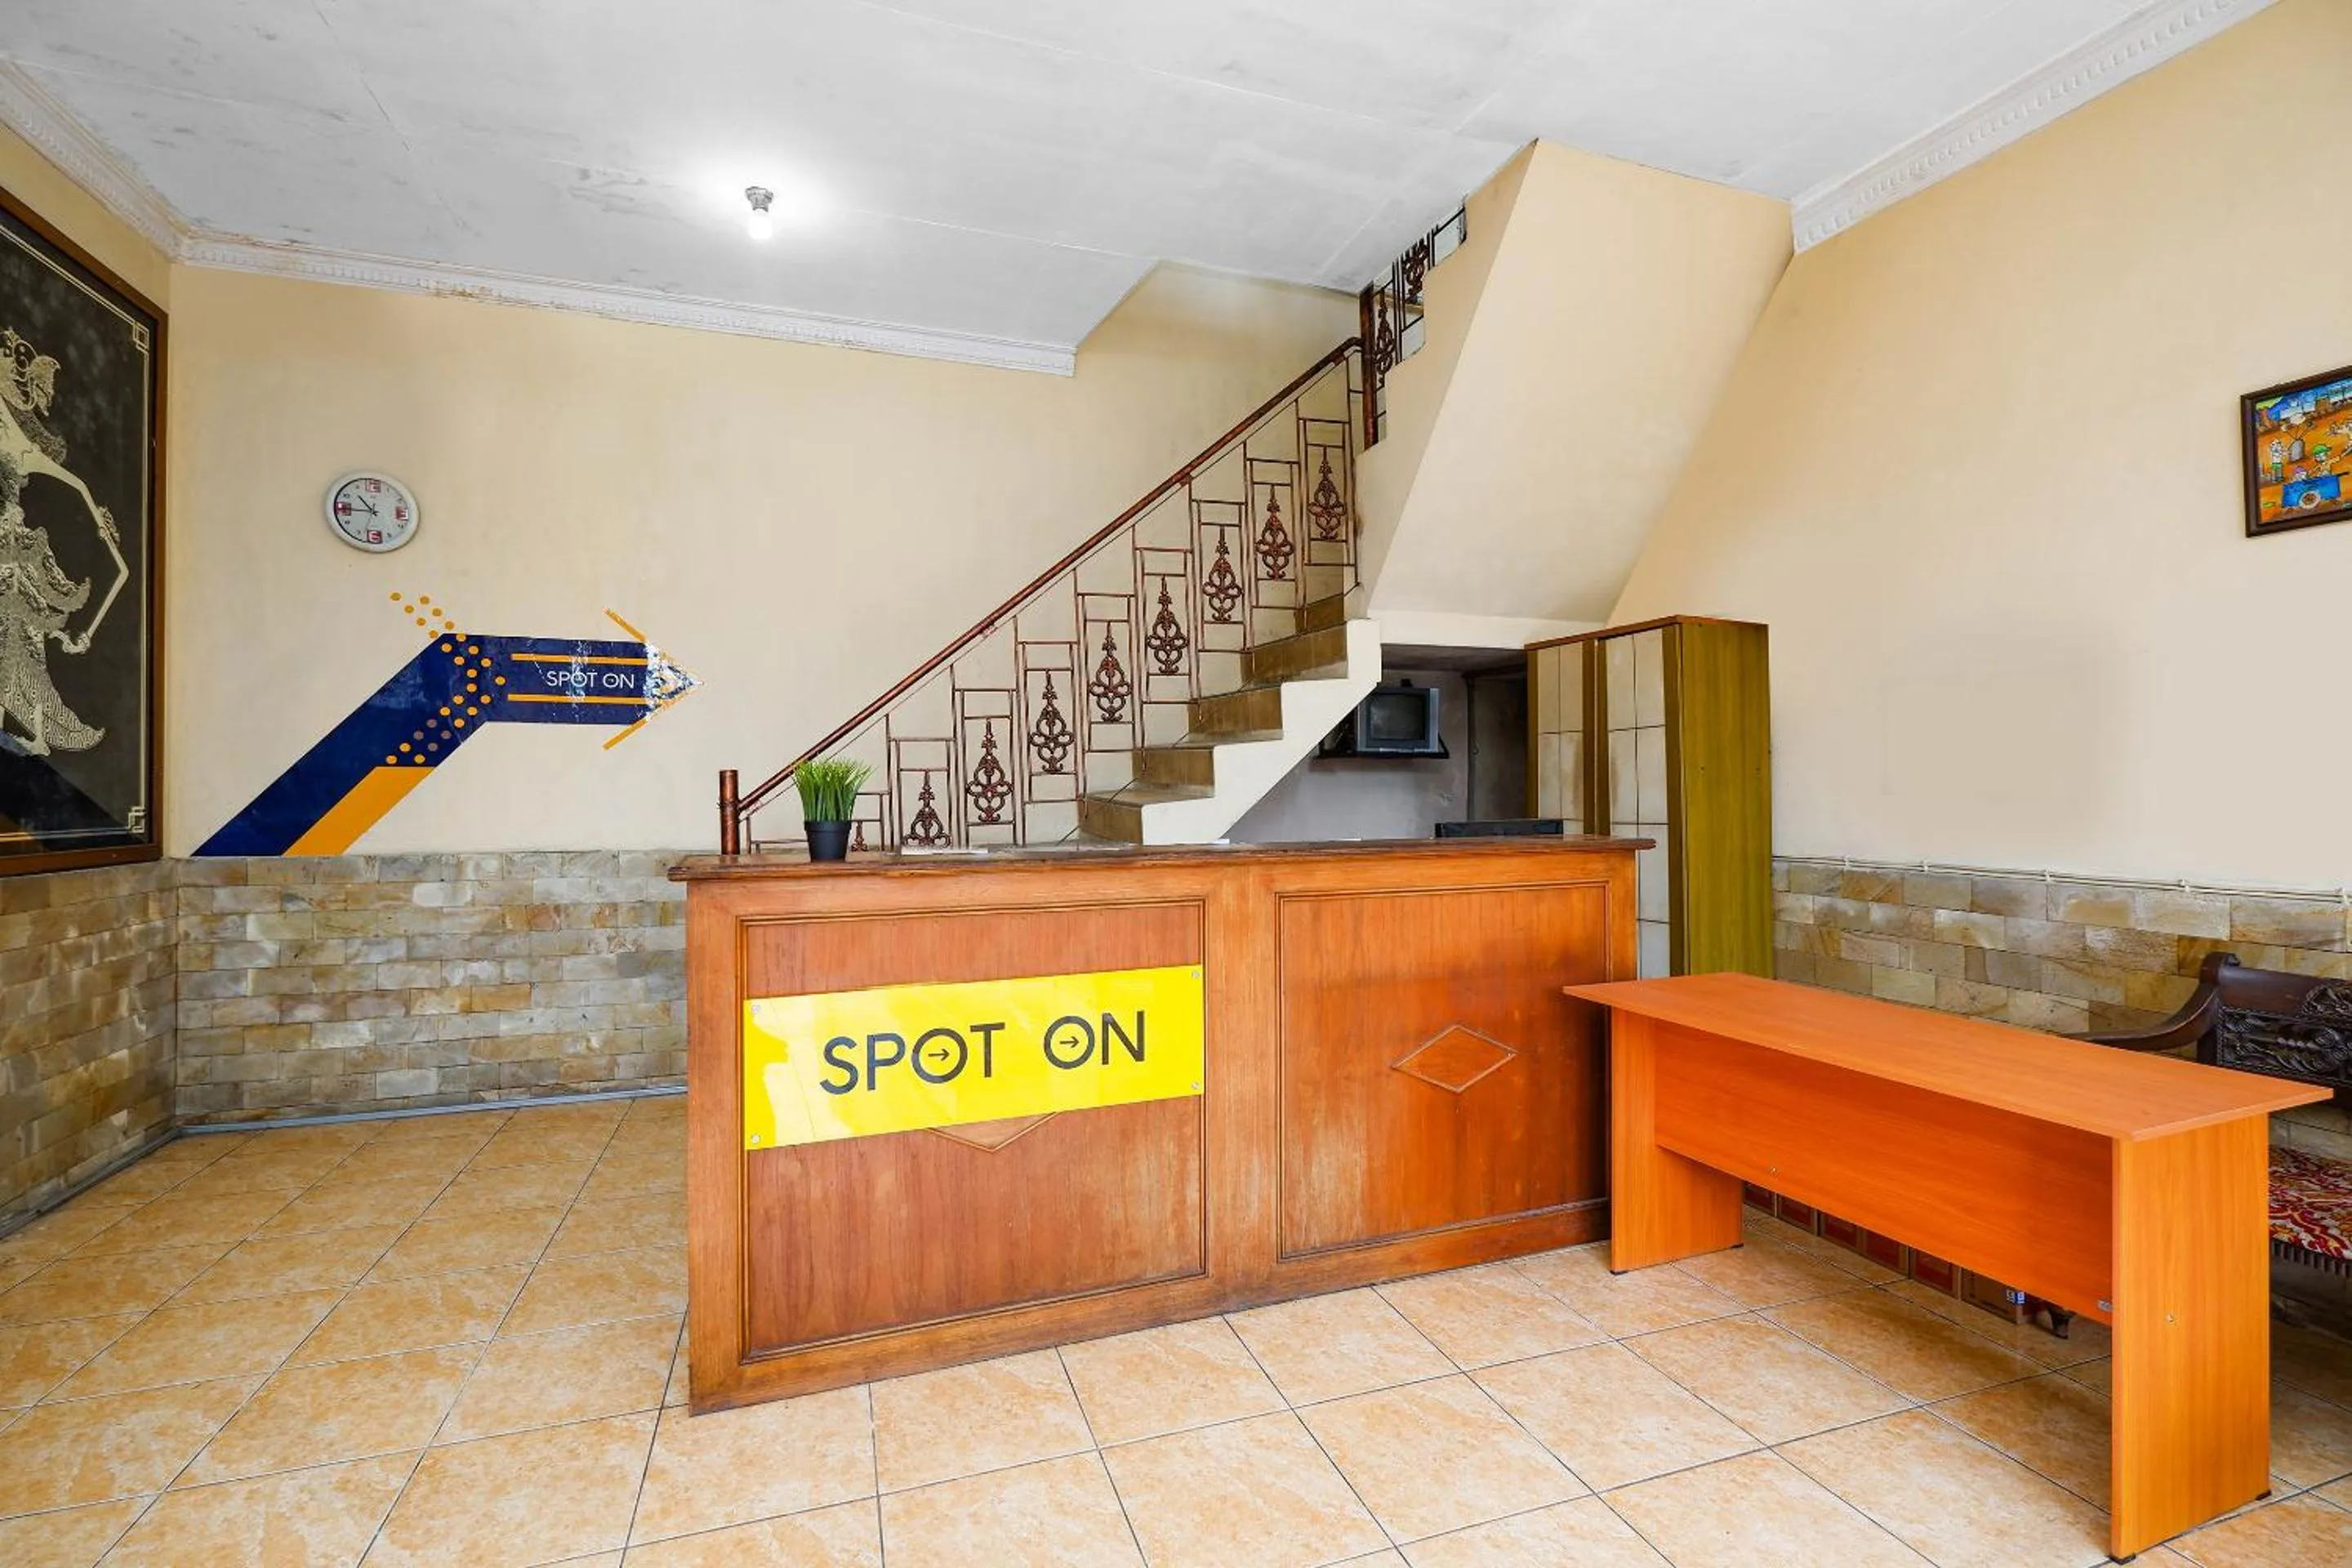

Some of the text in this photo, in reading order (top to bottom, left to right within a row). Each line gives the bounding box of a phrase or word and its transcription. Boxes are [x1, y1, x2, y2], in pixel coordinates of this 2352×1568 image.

[546, 670, 635, 688] SPOT ON
[819, 1010, 1145, 1095] SPOT ON
